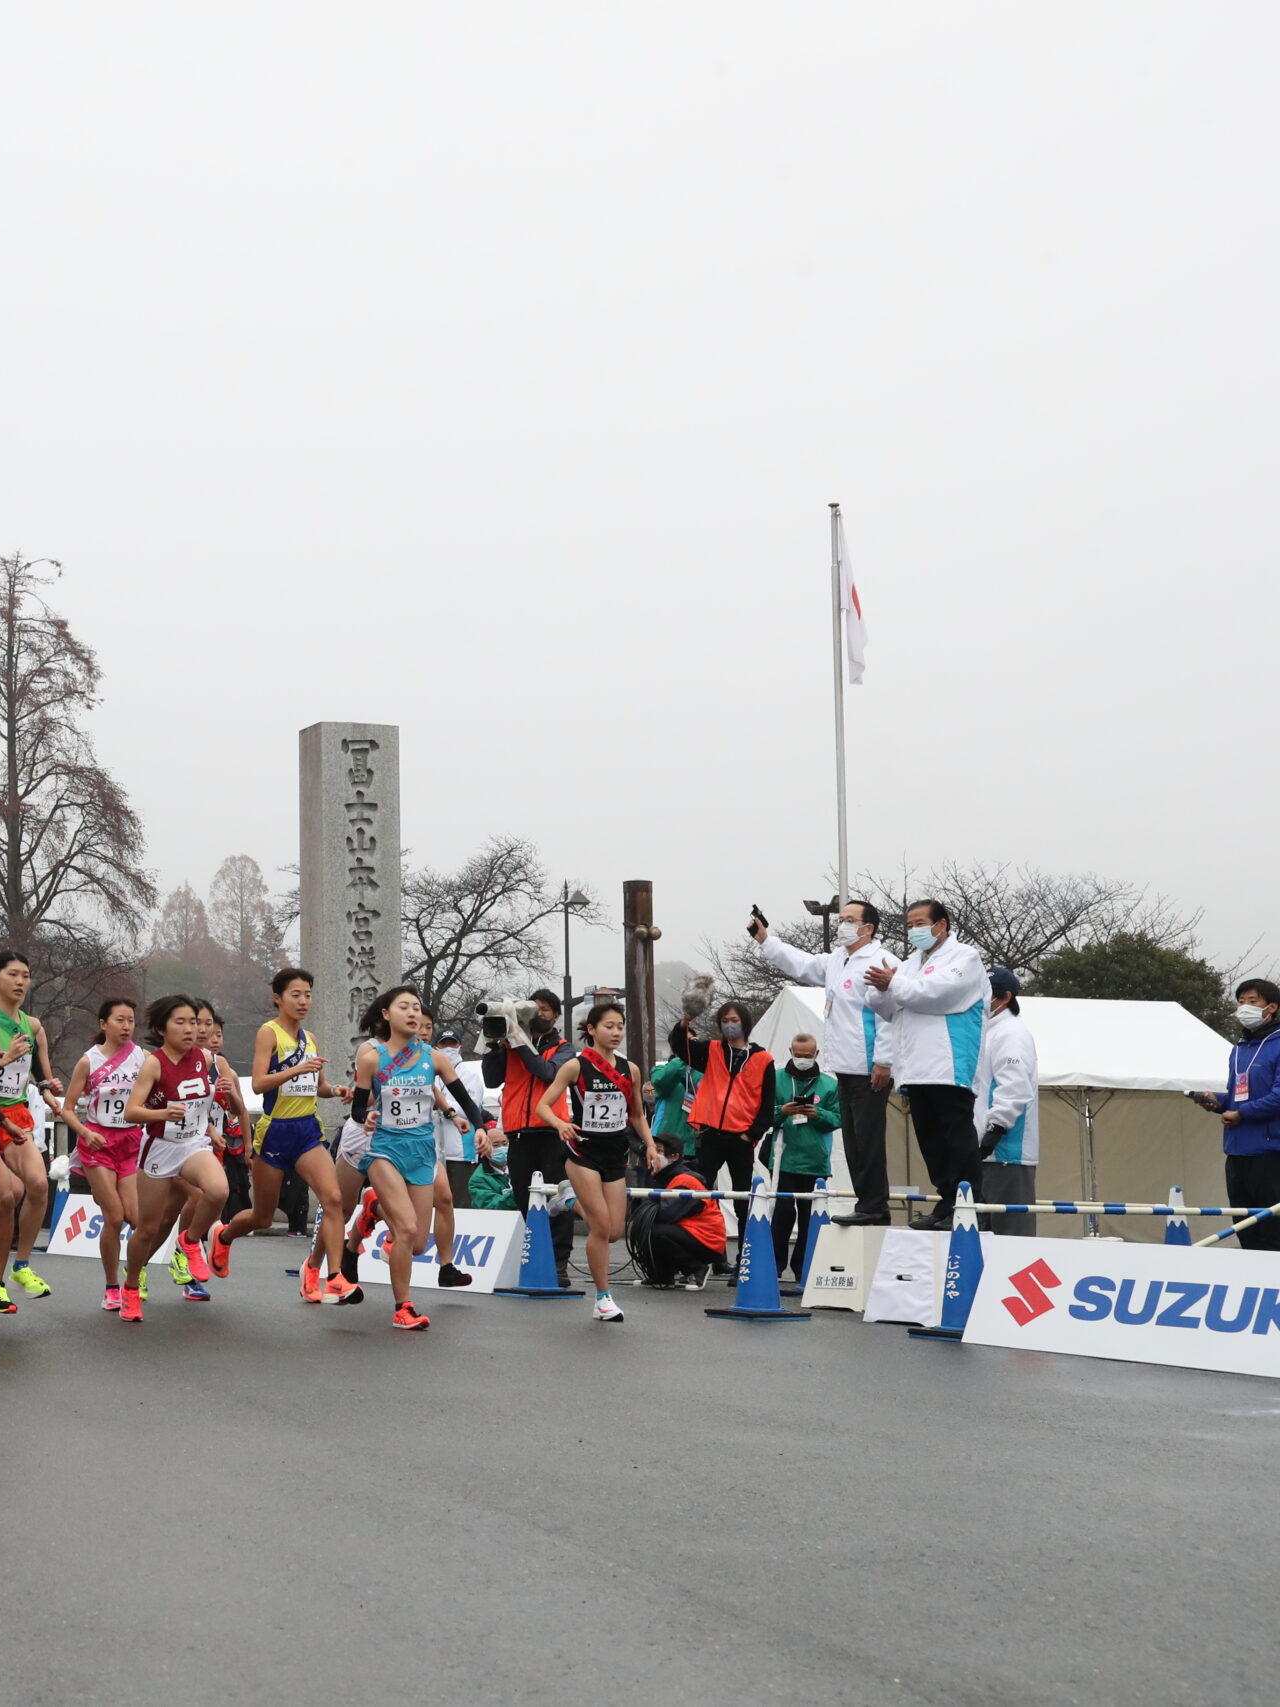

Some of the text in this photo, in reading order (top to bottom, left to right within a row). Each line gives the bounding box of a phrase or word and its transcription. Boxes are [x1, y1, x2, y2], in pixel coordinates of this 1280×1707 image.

[402, 1088, 424, 1096] アルト
[390, 1100, 421, 1117] 8-1
[589, 1104, 623, 1120] 12-1
[396, 1117, 418, 1126] 松山大
